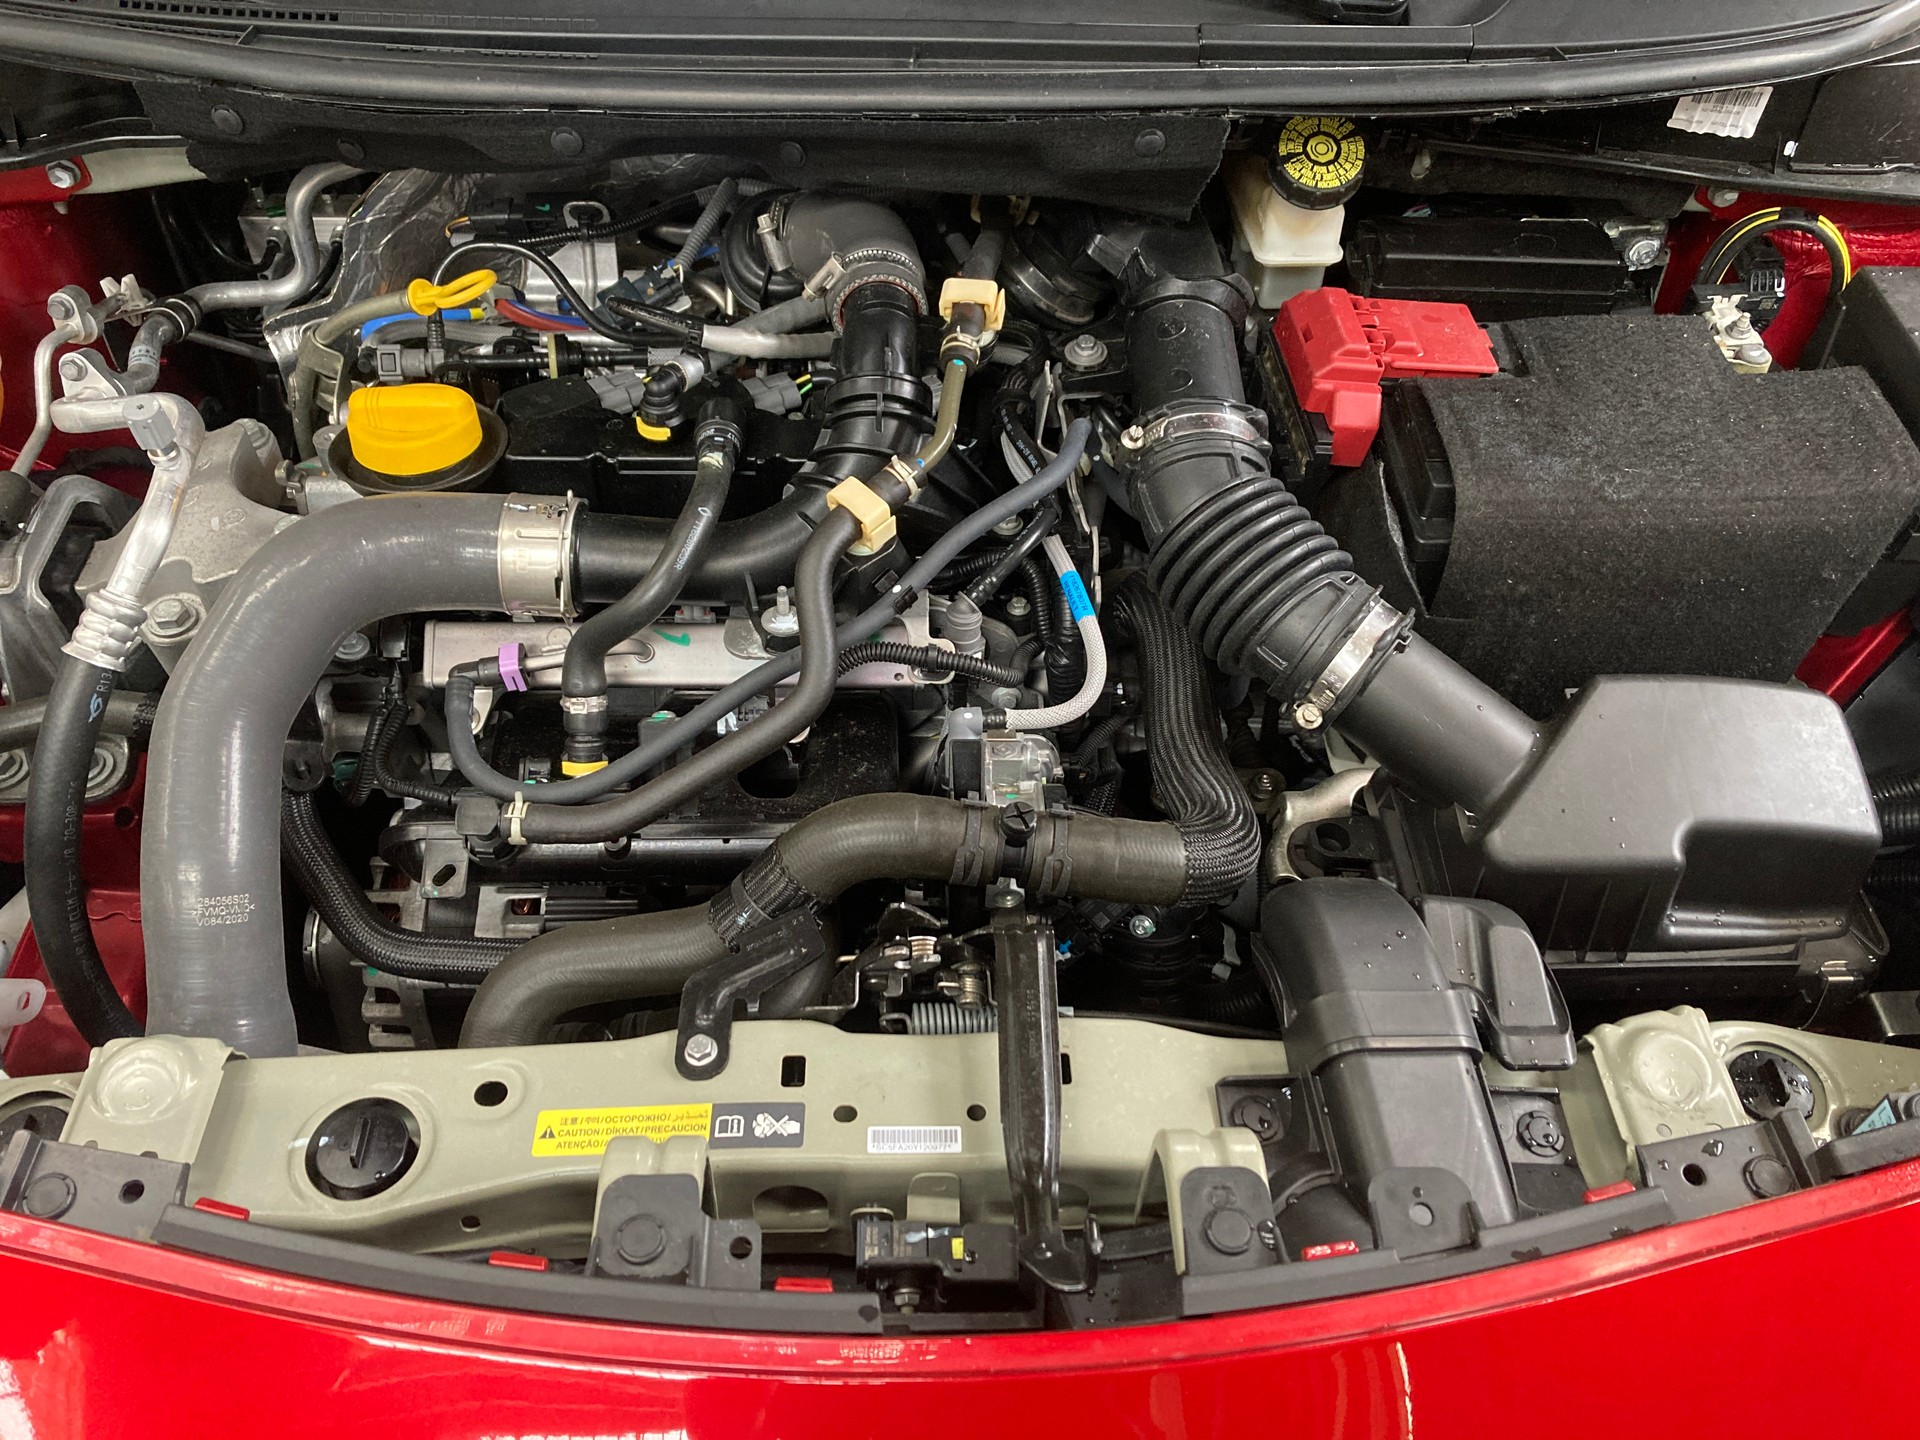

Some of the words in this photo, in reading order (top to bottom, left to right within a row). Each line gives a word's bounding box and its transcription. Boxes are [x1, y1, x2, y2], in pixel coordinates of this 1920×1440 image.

[1063, 580, 1079, 612] RENAULT
[96, 668, 113, 693] R13
[197, 893, 250, 907] 284056S02
[195, 913, 249, 927] V084/2020
